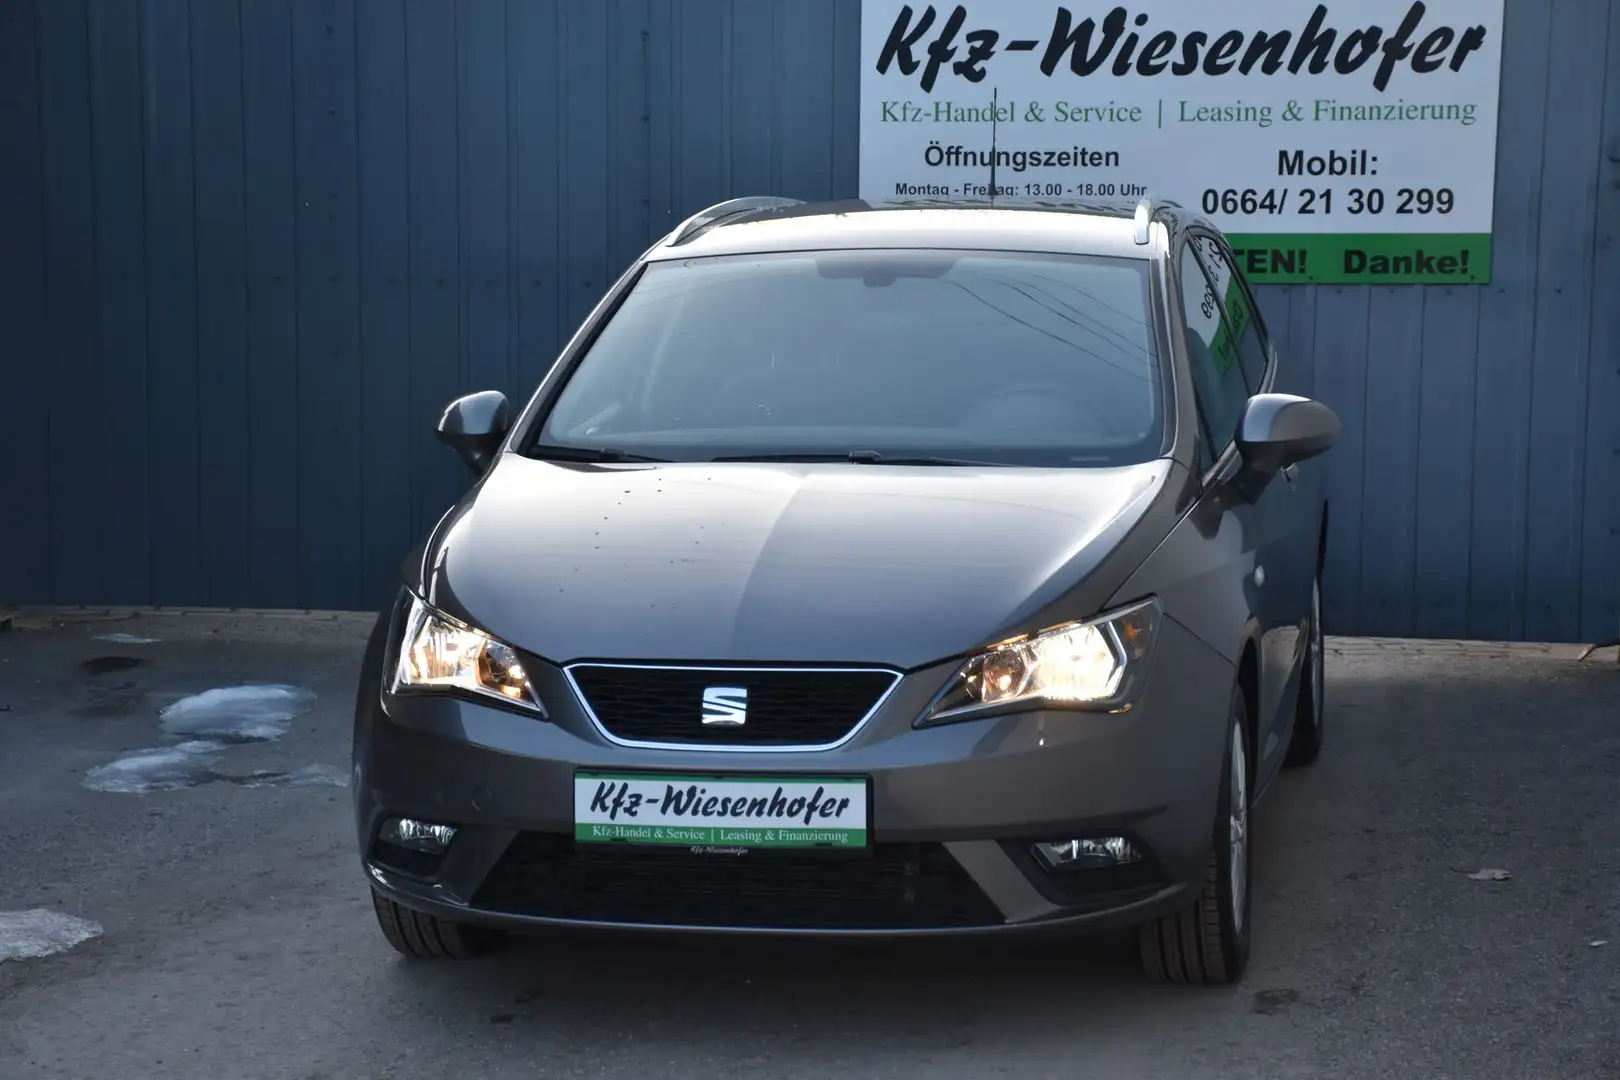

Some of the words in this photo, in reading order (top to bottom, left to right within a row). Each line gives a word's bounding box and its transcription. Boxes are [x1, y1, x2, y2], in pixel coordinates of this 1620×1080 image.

[876, 1, 1487, 93] Kfz-Wiesenhofer
[881, 101, 1015, 123] Kfz-Handel
[1025, 101, 1045, 123] &
[1054, 101, 1142, 123] Service
[1178, 100, 1274, 128] Leasing
[1282, 100, 1305, 122] &
[1314, 98, 1477, 126] Finanzierung
[924, 140, 1120, 173] Öffnungszeiten
[1278, 149, 1378, 176] Mobil:
[1024, 183, 1063, 196] 13.00
[1077, 183, 1116, 196] 18.00
[1120, 183, 1148, 196] Uhr
[1202, 187, 1289, 216] 0664/
[1297, 187, 1333, 215] 21
[1347, 187, 1385, 215] 30
[1395, 187, 1455, 215] 299
[1343, 248, 1471, 275] Danke!
[590, 781, 850, 826] Kfz-Wiesenhofer
[592, 825, 651, 837] Kfz-Handel
[653, 828, 665, 838] &
[666, 829, 705, 840] Service
[720, 829, 762, 844] Leasing
[765, 830, 776, 841] &
[778, 829, 849, 844] Finanzierung
